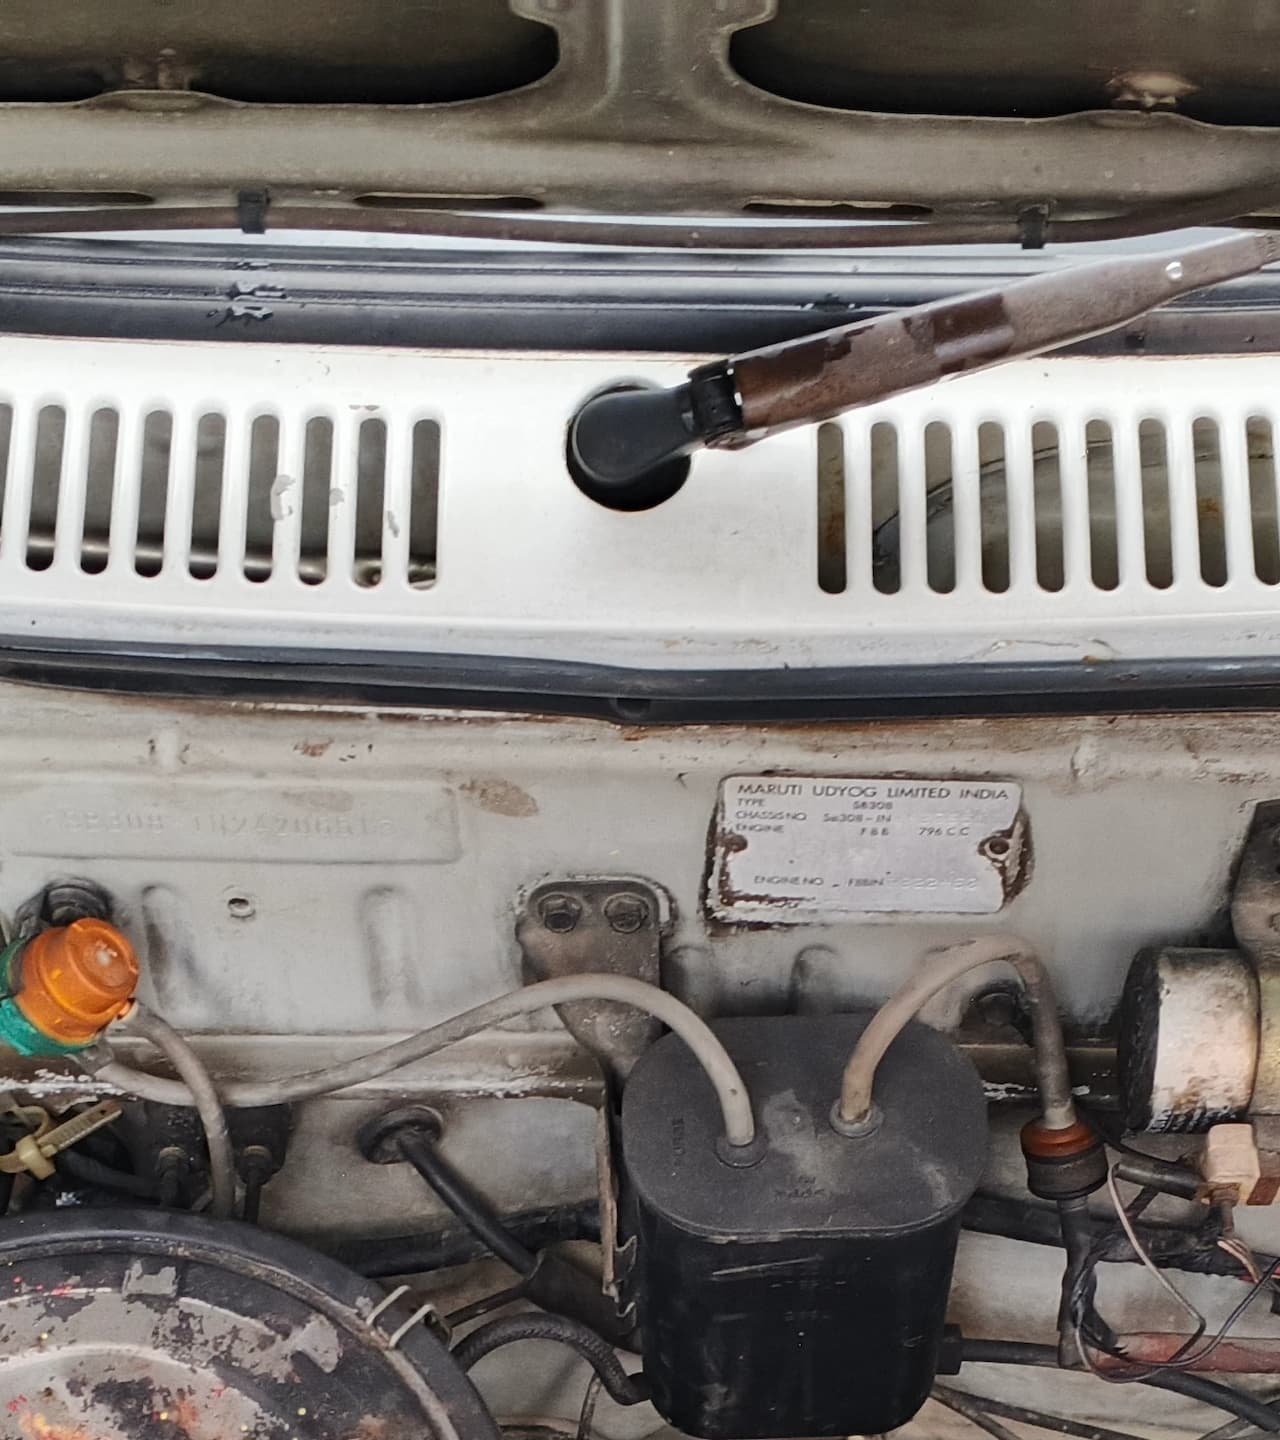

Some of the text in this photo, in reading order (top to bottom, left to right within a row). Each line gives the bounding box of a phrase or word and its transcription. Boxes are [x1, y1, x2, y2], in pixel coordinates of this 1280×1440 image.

[737, 784, 1009, 800] MARUTI UDYOG LIMITED INDIA
[737, 798, 765, 806] TYPE
[736, 824, 784, 833] ENGINE
